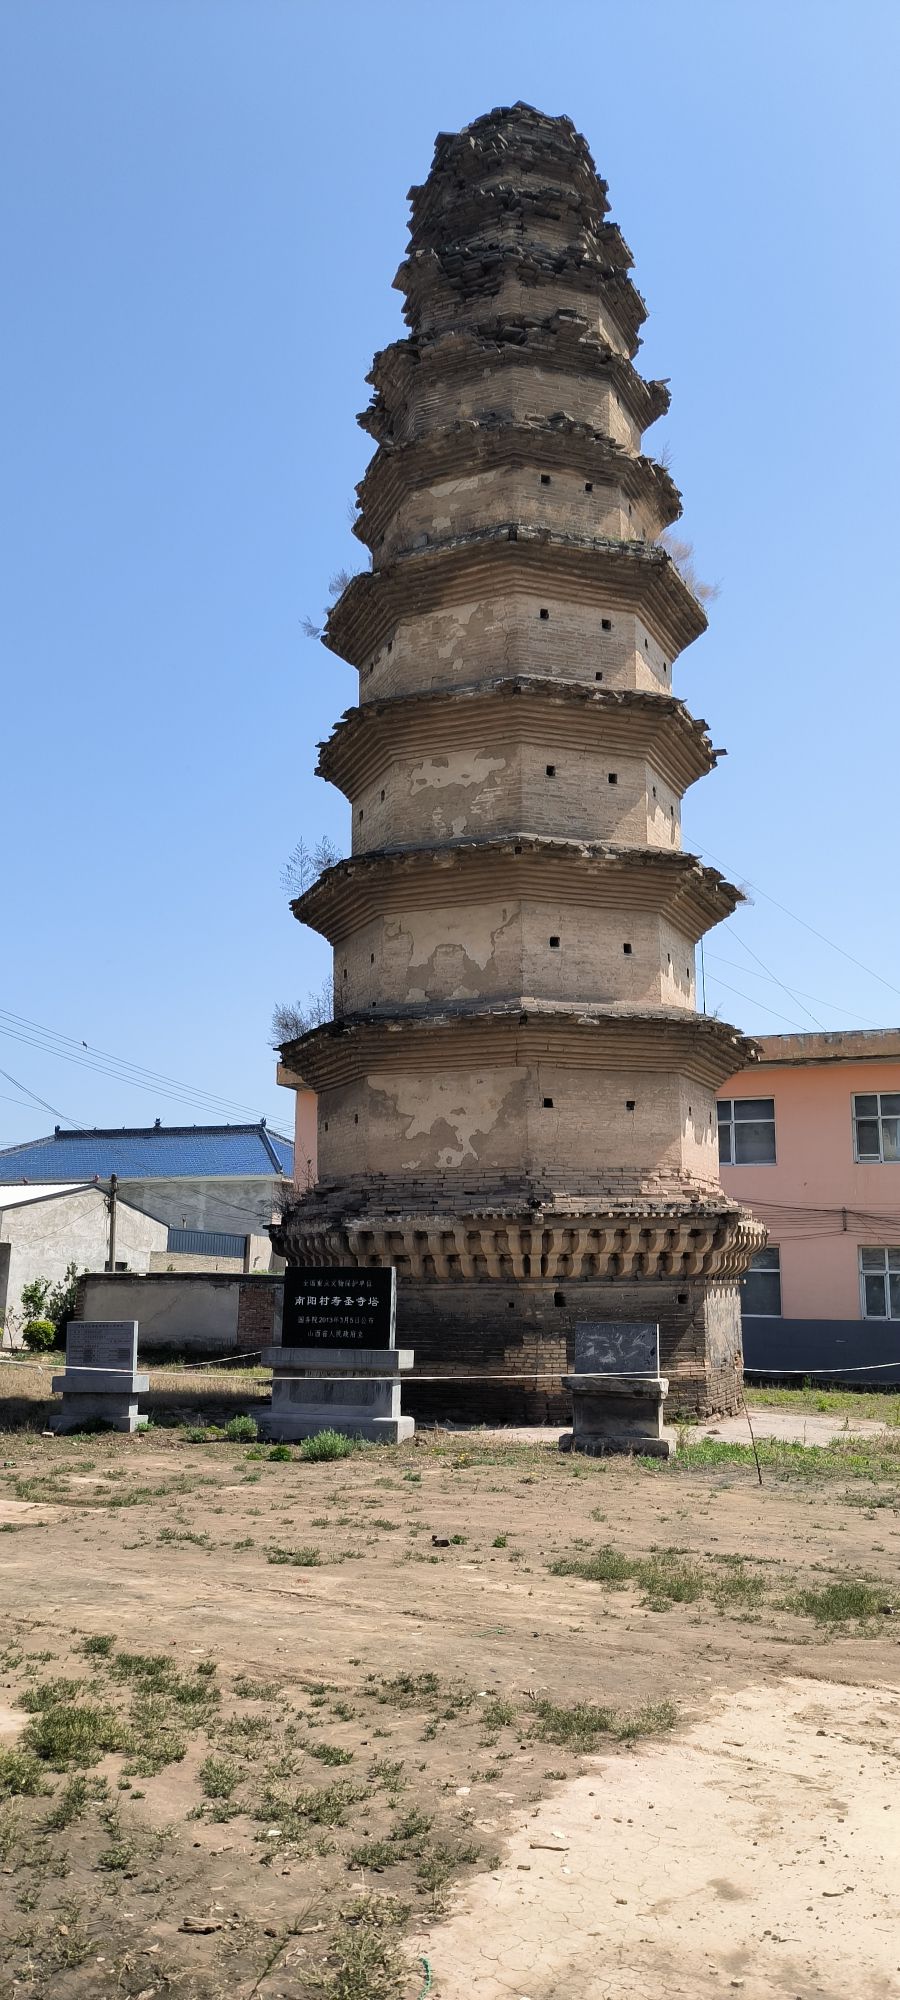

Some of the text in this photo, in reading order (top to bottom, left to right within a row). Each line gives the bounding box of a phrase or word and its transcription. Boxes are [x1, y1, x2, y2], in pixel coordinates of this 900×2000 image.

[294, 1295, 380, 1307] 南阳村寿圣寺塔
